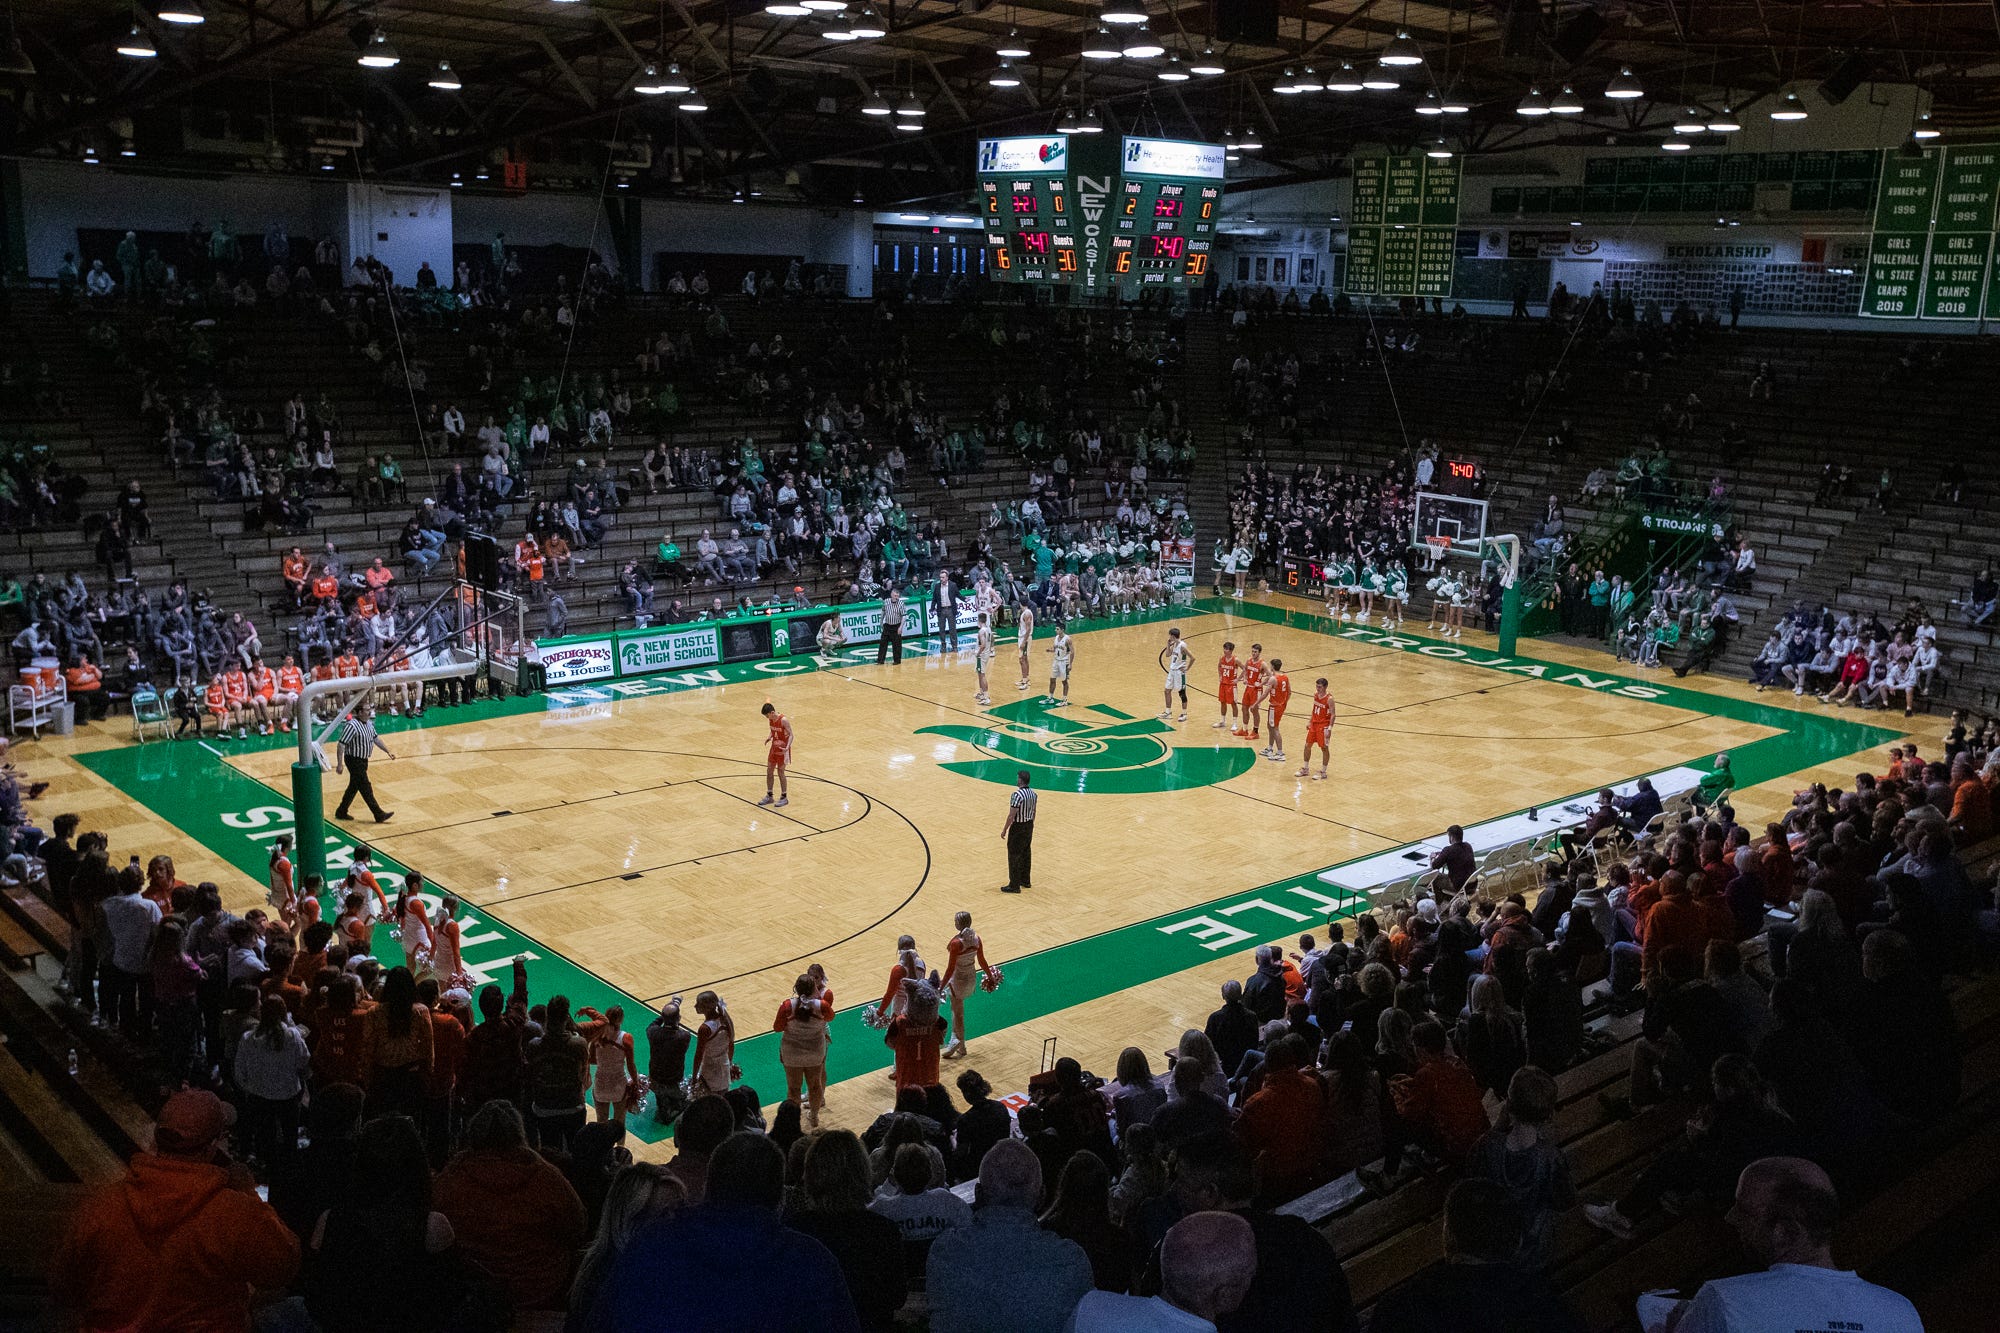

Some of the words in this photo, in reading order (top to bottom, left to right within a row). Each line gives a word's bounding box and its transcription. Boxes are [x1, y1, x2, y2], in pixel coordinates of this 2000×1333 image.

[1954, 156, 1994, 165] WRESTLING
[1900, 169, 1920, 177] STATE
[1959, 174, 1982, 184] STATE
[1013, 181, 1031, 192] player
[1049, 181, 1063, 191] fouls
[1125, 182, 1141, 192] fouls
[1162, 184, 1183, 195] player
[1888, 187, 1926, 196] RUNNER-UP
[1202, 188, 1217, 197] fouls
[1054, 196, 1063, 212] 0
[1948, 194, 1988, 203] RUNNER-UP
[990, 197, 997, 212] 2
[1126, 199, 1136, 215] 2
[1202, 201, 1211, 218] 0
[1893, 206, 1916, 214] 1996
[1953, 212, 1977, 221] 1995
[1020, 218, 1034, 227] game
[1120, 220, 1133, 228] won
[1157, 222, 1173, 232] game
[1196, 224, 1209, 232] won
[989, 234, 1004, 244] Home
[1018, 232, 1049, 254] 7:40
[1052, 234, 1074, 246] Guests
[1113, 237, 1132, 247] Home
[1887, 239, 1911, 248] GIRLS
[1948, 238, 1973, 249] GIRLS
[1152, 236, 1184, 258] 7:40
[1188, 240, 1209, 250] Guests
[1667, 245, 1772, 258] SCHOLARSHIP
[997, 248, 1010, 269] 16
[1058, 250, 1077, 271] 30
[1116, 252, 1132, 272] 16
[1873, 254, 1920, 265] VOLLEYBALL
[1933, 254, 1983, 265] VOLLEYBALL
[1186, 254, 1208, 275] 30
[1026, 269, 1042, 279] period
[1144, 273, 1164, 283] period
[1876, 270, 1884, 280] 4A
[1891, 270, 1914, 280] STATE
[1935, 271, 1945, 281] 3A
[1952, 270, 1978, 281] STATE
[1877, 285, 1908, 296] CHAMPS
[1937, 286, 1970, 297] CHAMPS
[1876, 301, 1904, 311] 2019
[1937, 302, 1966, 313] 2018
[1450, 462, 1473, 478] 7:40
[1656, 518, 1706, 533] TROJANS
[1308, 564, 1327, 581] 7:4
[842, 616, 867, 627] HOME
[872, 614, 881, 624] OF
[851, 626, 881, 637] TROJA
[643, 640, 669, 652] NEW
[674, 634, 714, 648] CASTLE
[542, 649, 611, 668] SNEDIGAR'S
[645, 652, 670, 664] HIGH
[674, 646, 716, 660] SCHOOL
[1338, 628, 1669, 699] TROJANS
[546, 671, 566, 679] RIB
[571, 665, 611, 676] HOUSE
[1282, 681, 1286, 692] 2
[1156, 886, 1367, 951] TLE
[916, 1042, 921, 1060] 1
